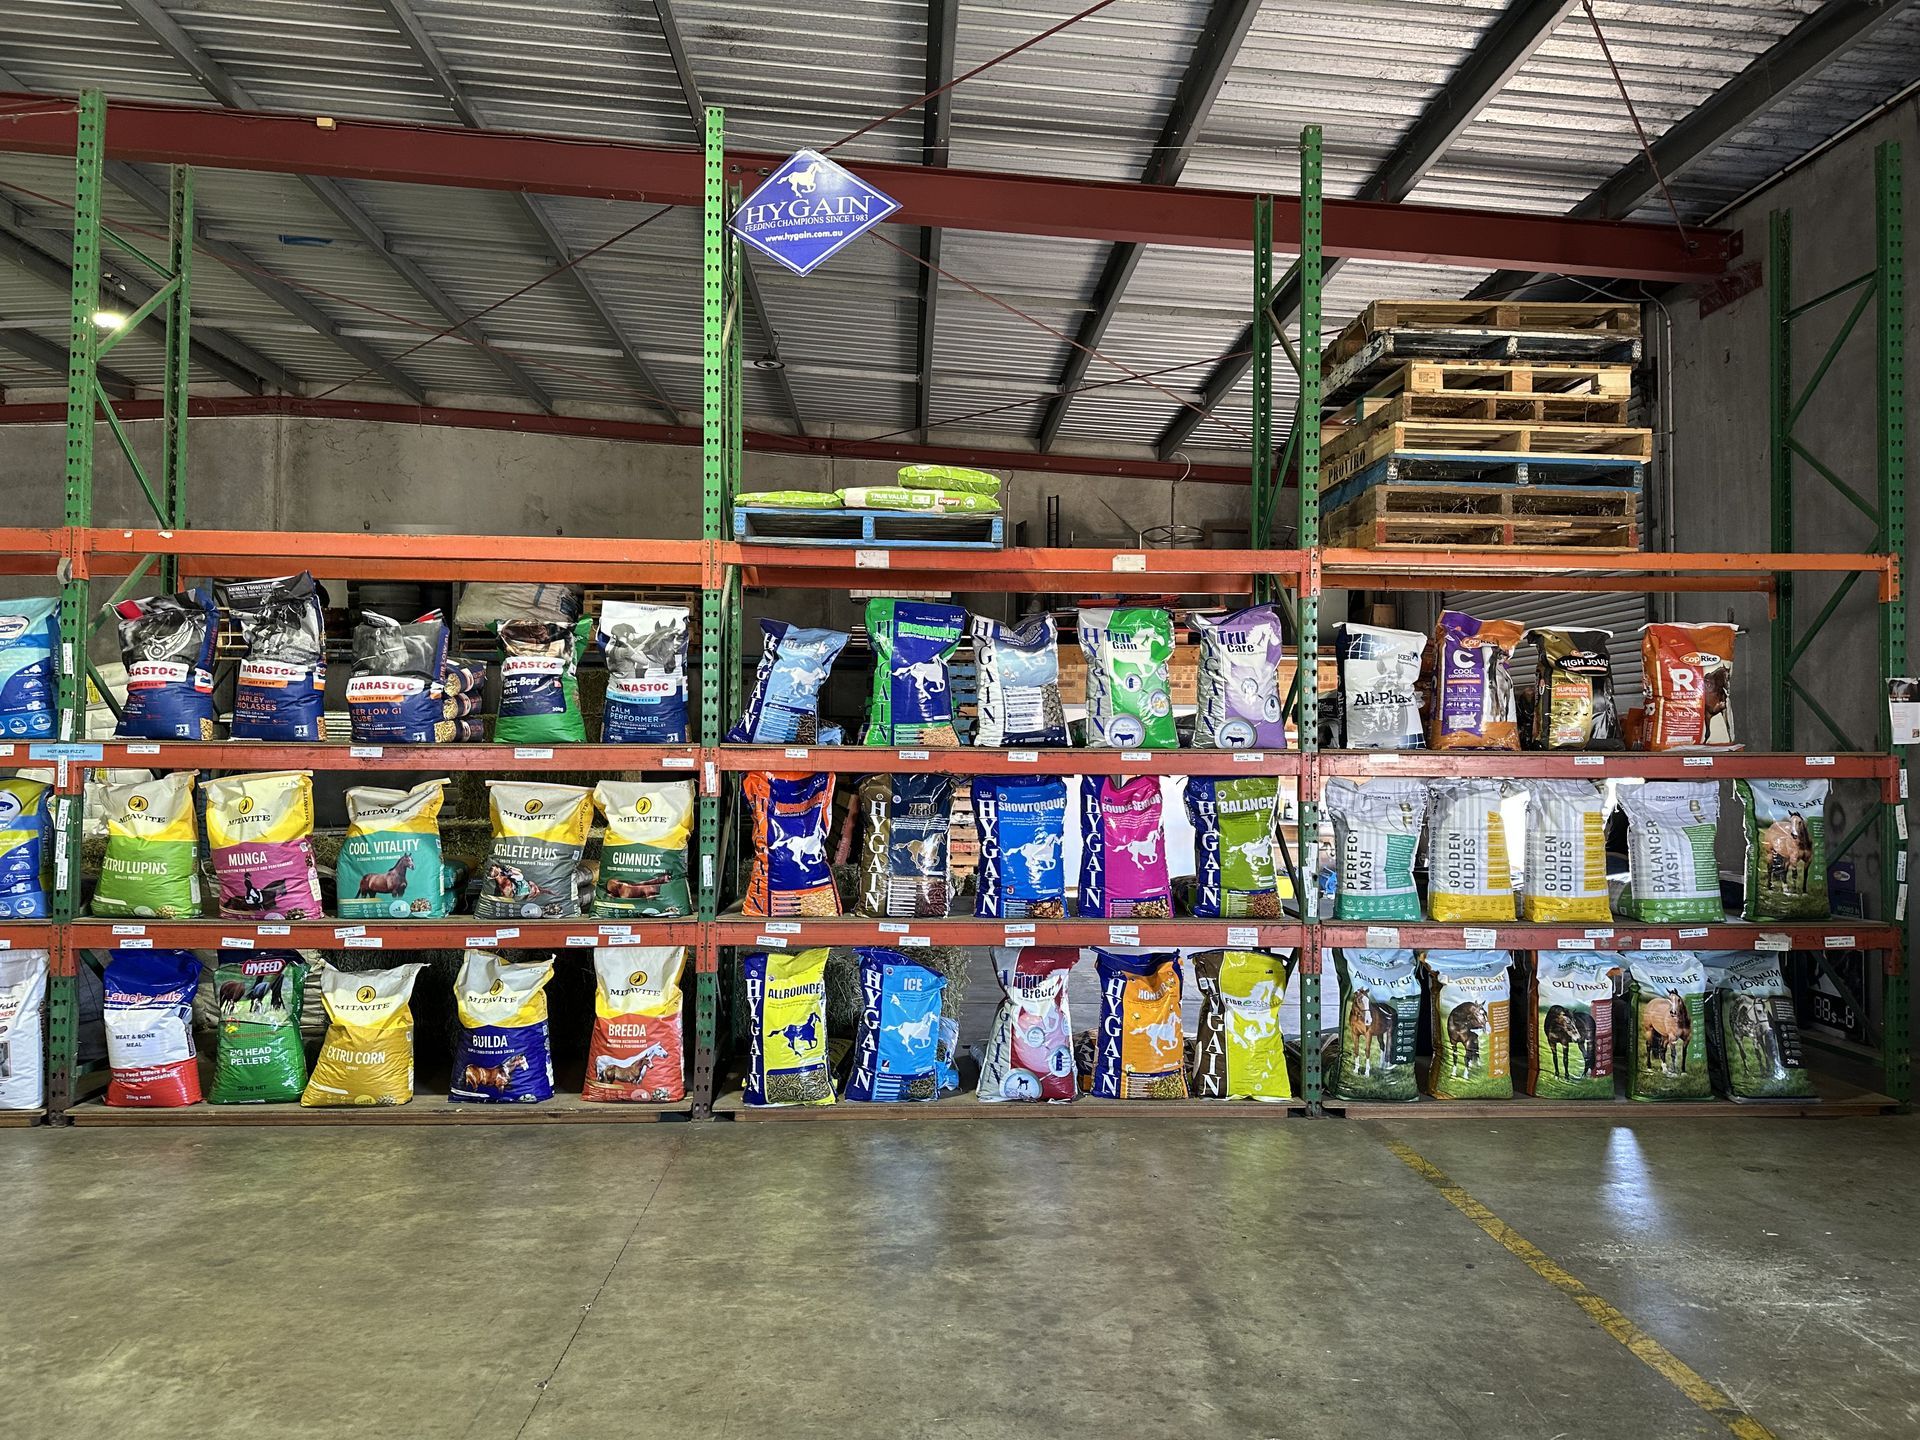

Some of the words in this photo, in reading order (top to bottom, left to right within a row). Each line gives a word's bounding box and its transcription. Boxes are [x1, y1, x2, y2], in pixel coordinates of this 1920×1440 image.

[744, 195, 872, 226] HYGAIN
[744, 221, 776, 233] FEEDING
[777, 216, 825, 228] CHAMPIONS
[825, 214, 850, 225] SINCE
[851, 213, 869, 223] 1983
[765, 229, 844, 243] www.hygain.com.au
[1104, 629, 1131, 643] Tru
[1217, 630, 1247, 645] Tru
[1112, 641, 1138, 651] Gain
[1227, 643, 1254, 653] Care
[1397, 654, 1412, 662] KER
[1453, 649, 1476, 669] C
[1683, 654, 1717, 664] CopRice
[128, 666, 178, 678] RASTOC
[1670, 668, 1696, 691] R
[616, 682, 669, 693] ARASTOC
[873, 619, 893, 743] HGAIN
[368, 707, 389, 715] LOW
[391, 707, 402, 715] GI
[610, 705, 630, 715] CALM
[609, 712, 660, 724] PERFORMER
[908, 801, 938, 816] ZERO
[998, 797, 1066, 814] SHOWTORQUE
[1772, 797, 1798, 808] FIBRE
[1798, 797, 1824, 809] SAFE
[503, 809, 556, 822] MITAVITE
[617, 815, 667, 824] MITAVITE
[349, 842, 372, 855] COOL
[373, 838, 421, 854] VITALITY
[493, 844, 531, 859] ATHLETE
[532, 846, 558, 861] PLUS
[1085, 794, 1103, 909] HYGAIN
[1196, 800, 1220, 907] HYGAIN
[228, 850, 268, 867] MUNGA
[612, 851, 662, 867] GUMNUTS
[866, 799, 887, 913] HYGAIN
[977, 799, 1000, 916] HYGAIN
[1346, 828, 1359, 890] PERFECT
[1448, 832, 1461, 889] GOLDEN
[1463, 837, 1476, 890] OLDIES
[1646, 819, 1666, 893] BALANCER
[127, 861, 168, 875] LUPINS
[1360, 850, 1373, 891] MASH
[1545, 835, 1558, 893] GOLDEN
[1560, 840, 1572, 892] OLDIES
[1665, 851, 1681, 893] MASH
[245, 961, 283, 976] HYFEED
[903, 977, 923, 992] ICE
[1013, 972, 1043, 990] Tru
[1552, 980, 1575, 989] OLD
[1650, 973, 1676, 985] FIBRE
[1676, 973, 1701, 985] SAFE
[1739, 979, 1768, 992] LOW
[1769, 978, 1780, 989] GI
[467, 994, 517, 1004] MITAVITE
[609, 986, 661, 997] MITAVITE
[334, 1002, 390, 1011] MITAVITE
[115, 1033, 131, 1041] MEAT
[137, 1032, 156, 1040] BONE
[608, 1023, 647, 1037] BREEDA
[746, 978, 762, 1093] HYGAIN
[854, 968, 882, 1091] HYGAIN
[1102, 978, 1126, 1096] HYGAIN
[472, 1033, 509, 1048] BUILDA
[245, 1047, 272, 1056] HEAD
[326, 1045, 354, 1064] EXTRU
[355, 1049, 386, 1065] CORN
[230, 1055, 271, 1066] PELLETS
